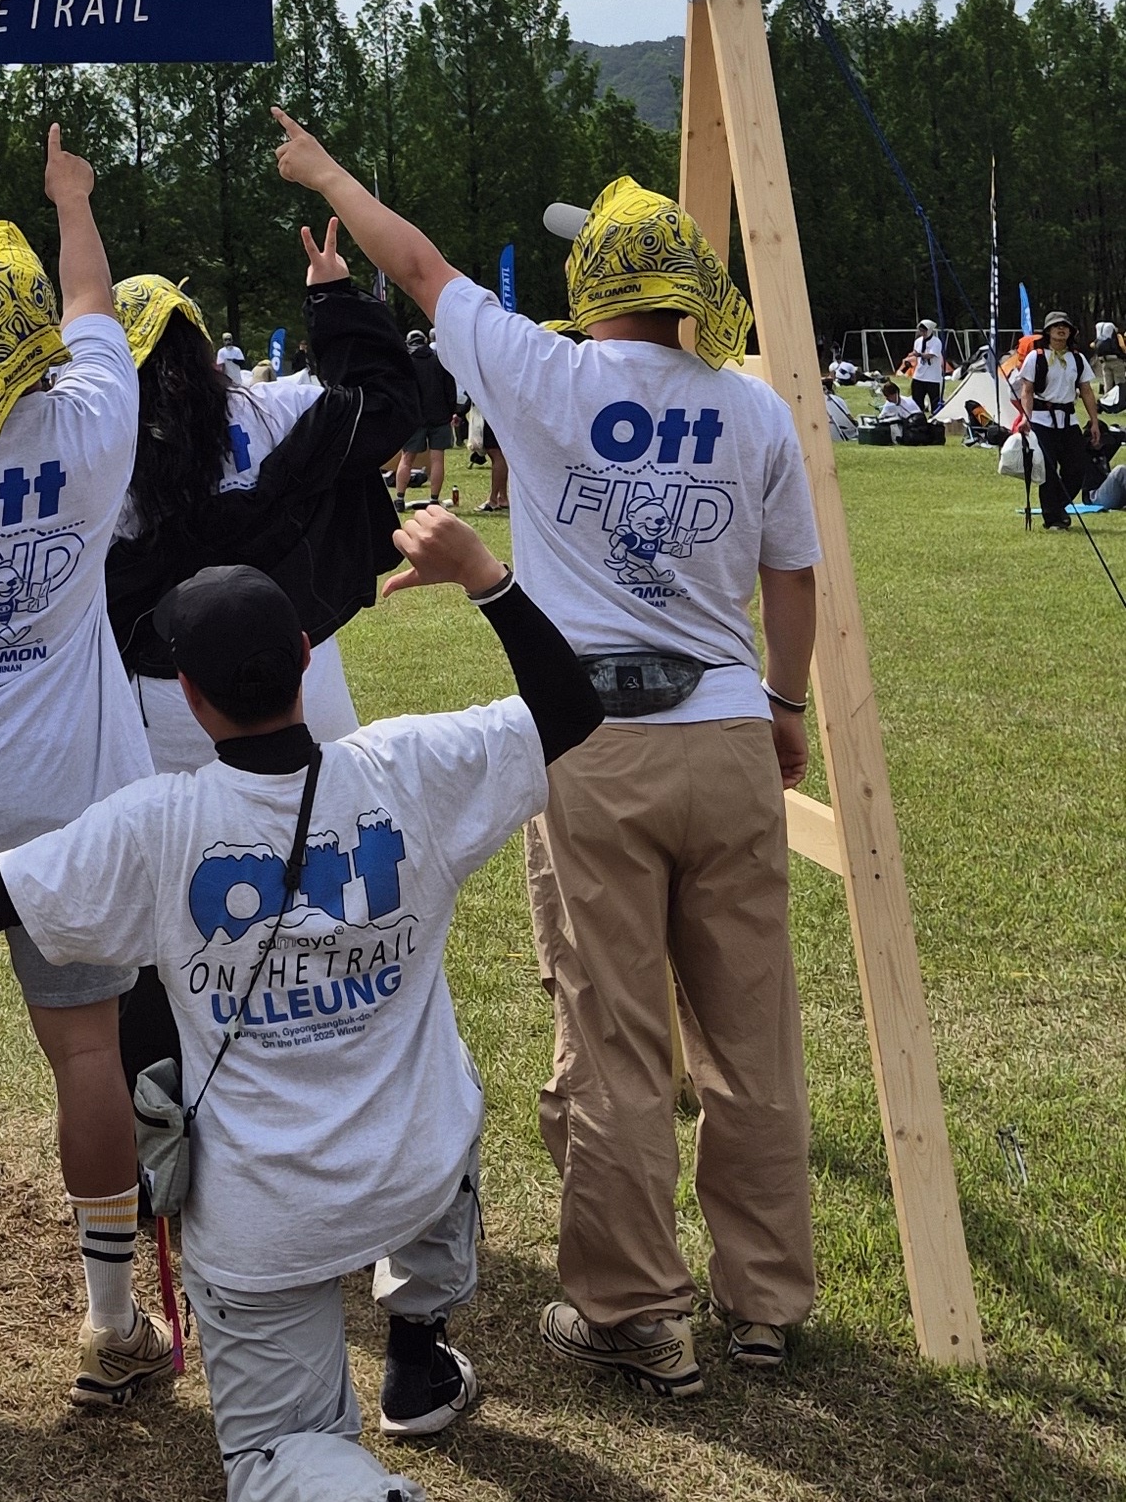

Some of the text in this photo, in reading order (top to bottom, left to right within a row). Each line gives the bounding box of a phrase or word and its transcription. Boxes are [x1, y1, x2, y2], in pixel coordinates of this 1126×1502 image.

[588, 284, 641, 302] SALOMON
[591, 401, 724, 464] Ott
[556, 472, 734, 544] FIND
[189, 962, 235, 994] ON
[325, 926, 416, 978] TRAIL
[211, 964, 402, 1026] ULLEUNG
[262, 1024, 367, 1049] On the trail 2025 Winter
